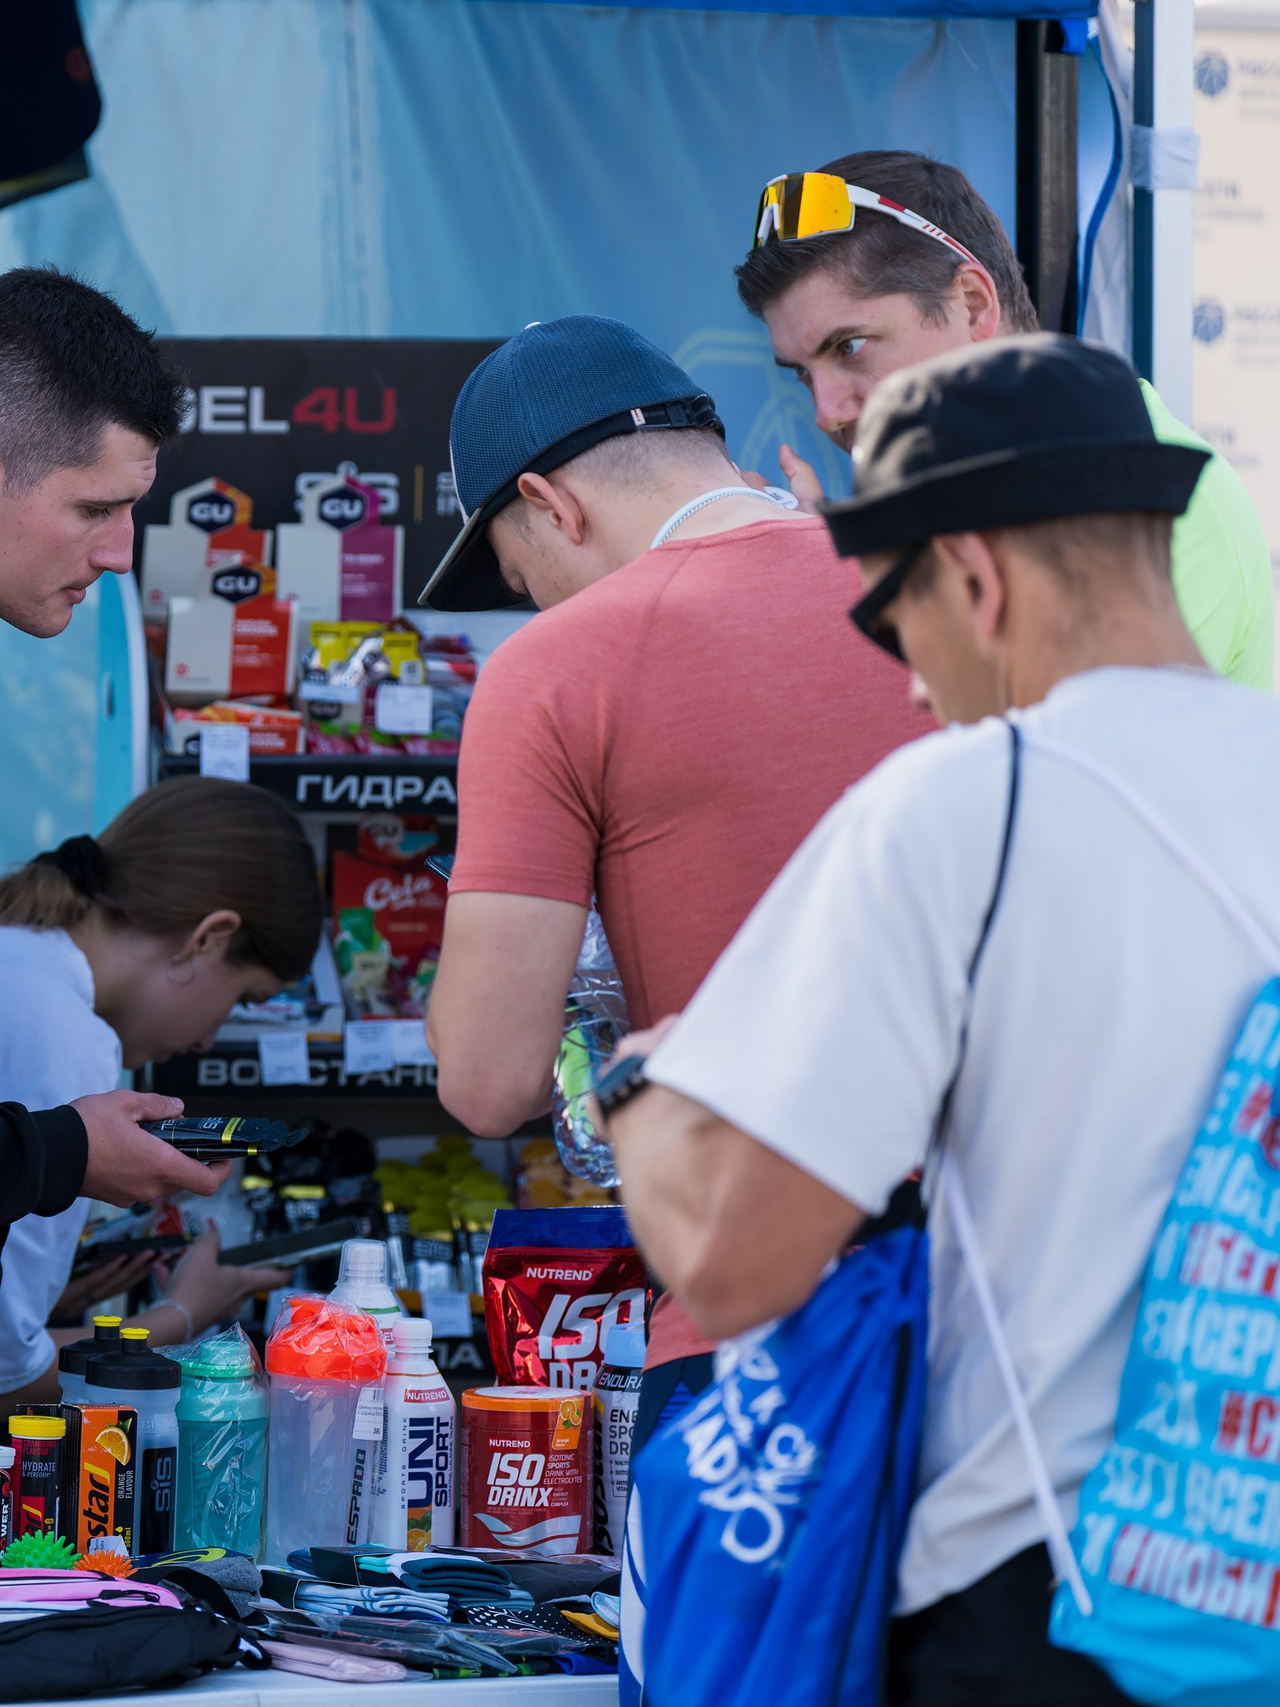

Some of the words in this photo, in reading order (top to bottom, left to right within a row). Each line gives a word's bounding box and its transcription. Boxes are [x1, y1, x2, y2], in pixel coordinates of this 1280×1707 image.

[190, 503, 232, 521] GU
[321, 498, 363, 519] GU
[215, 575, 257, 592] GU
[526, 1267, 593, 1282] NUTREND
[406, 1389, 448, 1401] NUTREND
[23, 1447, 49, 1455] FLAVOUR
[489, 1439, 531, 1448] NUTREND
[22, 1461, 56, 1472] HYDRATE
[407, 1417, 435, 1508] UNI
[435, 1416, 450, 1507] SPORT
[487, 1452, 546, 1487] ISO
[118, 1473, 126, 1499] ORANGE
[125, 1470, 133, 1499] FLAVOUR
[543, 1476, 583, 1485] ELECTROLYTES
[346, 1449, 366, 1545] ESPADO
[487, 1486, 553, 1507] DRINX
